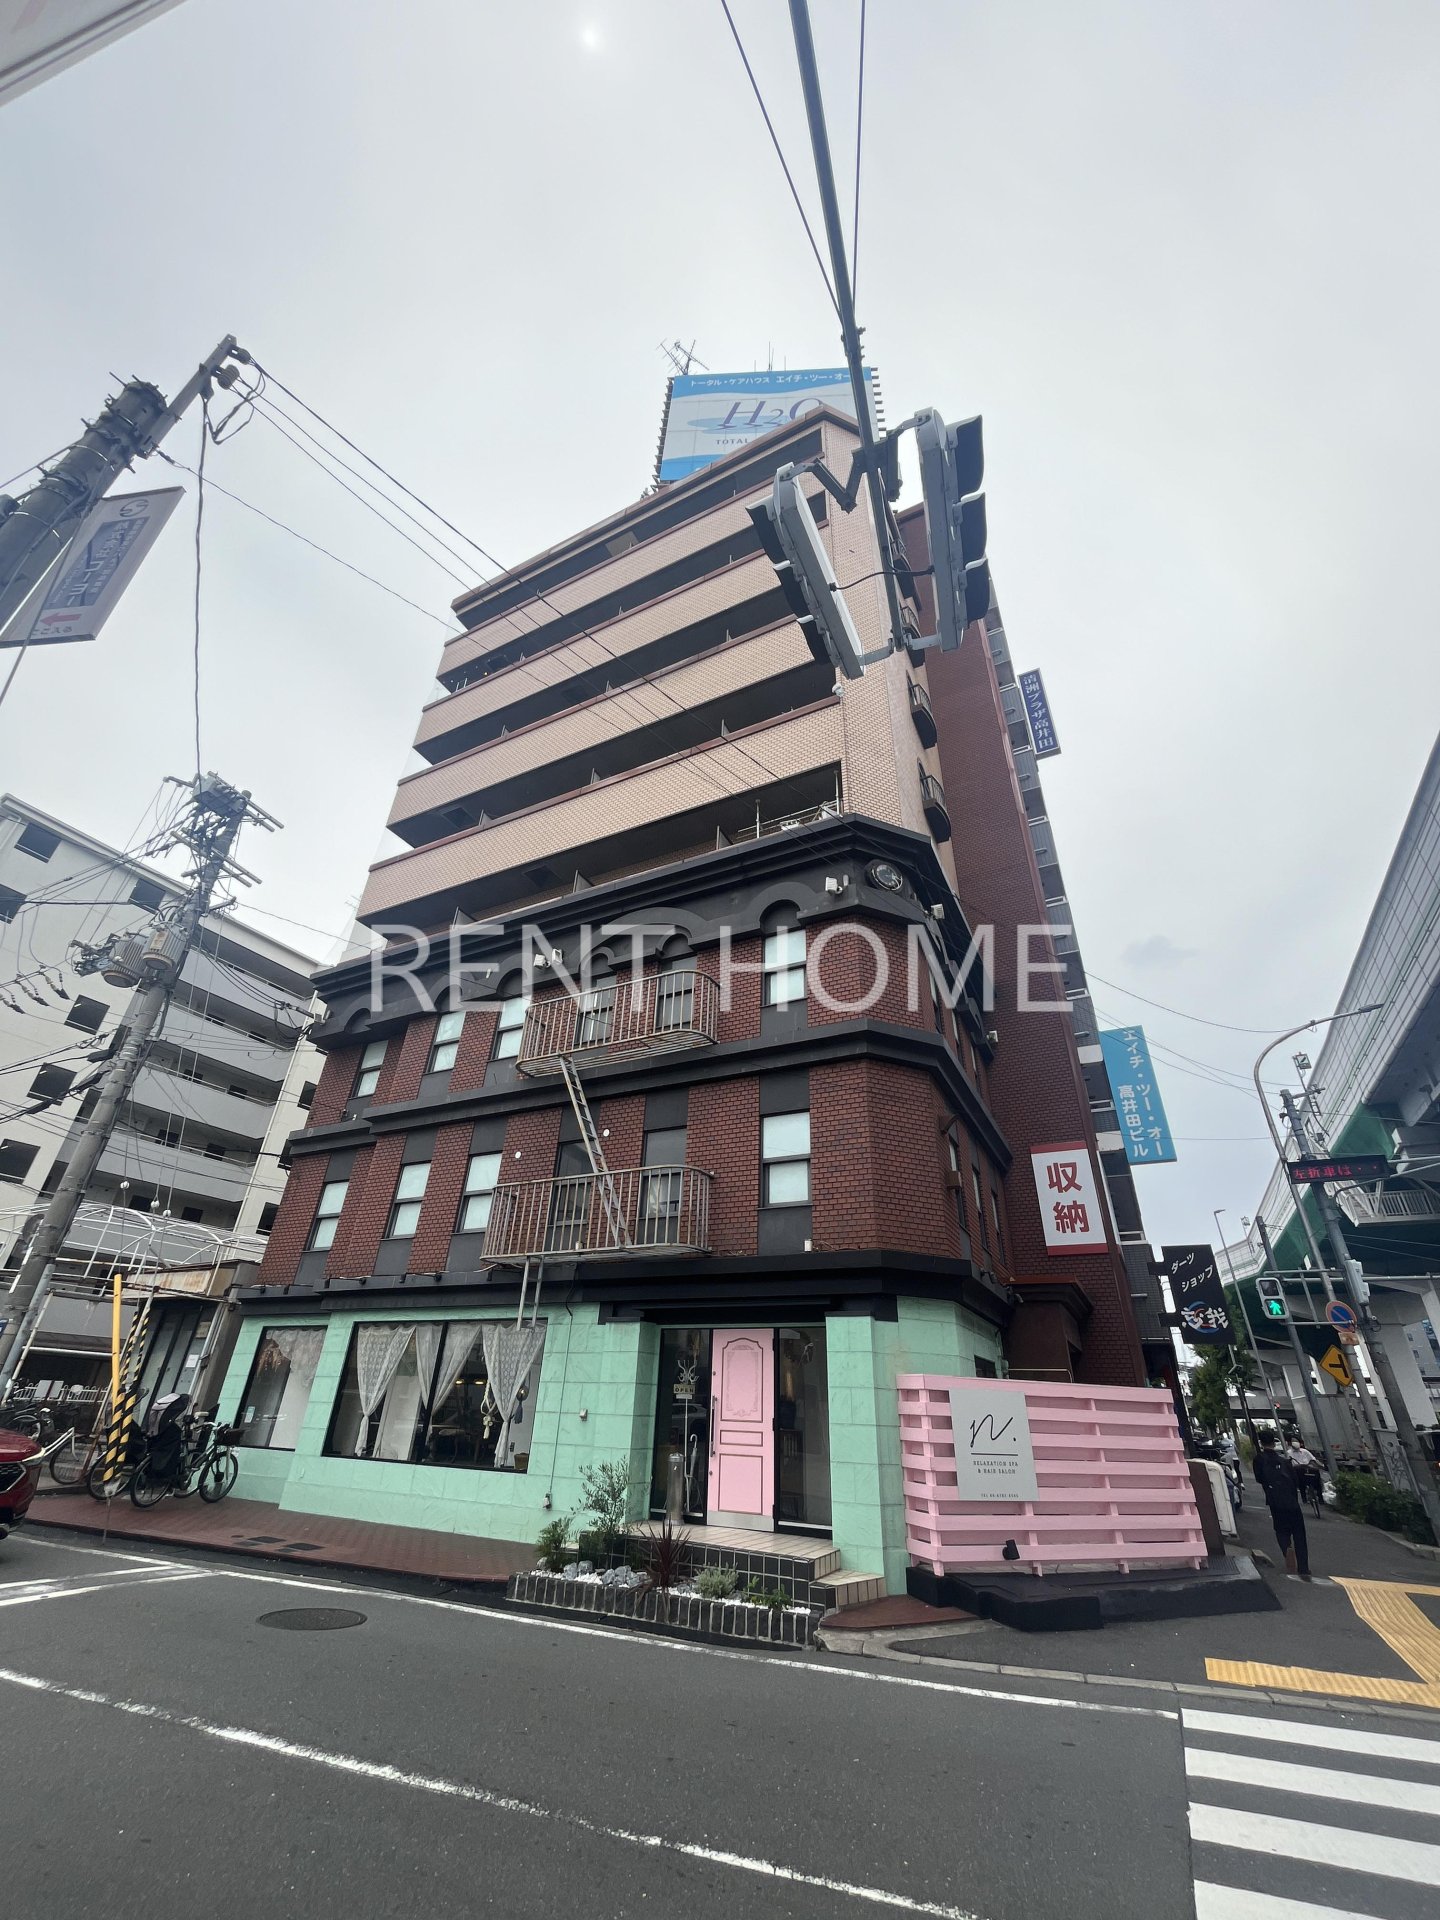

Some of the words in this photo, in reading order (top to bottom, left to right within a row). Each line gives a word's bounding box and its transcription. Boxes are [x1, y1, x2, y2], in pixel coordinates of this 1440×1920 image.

[690, 375, 770, 388] トータル・ケアハウス
[1123, 1030, 1162, 1156] エイチ・ツー・オー
[1117, 1084, 1149, 1158] 高井田ビル
[1046, 1161, 1090, 1234] 収納
[1171, 1252, 1196, 1274] ダーツ
[1181, 1264, 1214, 1293] ショップ
